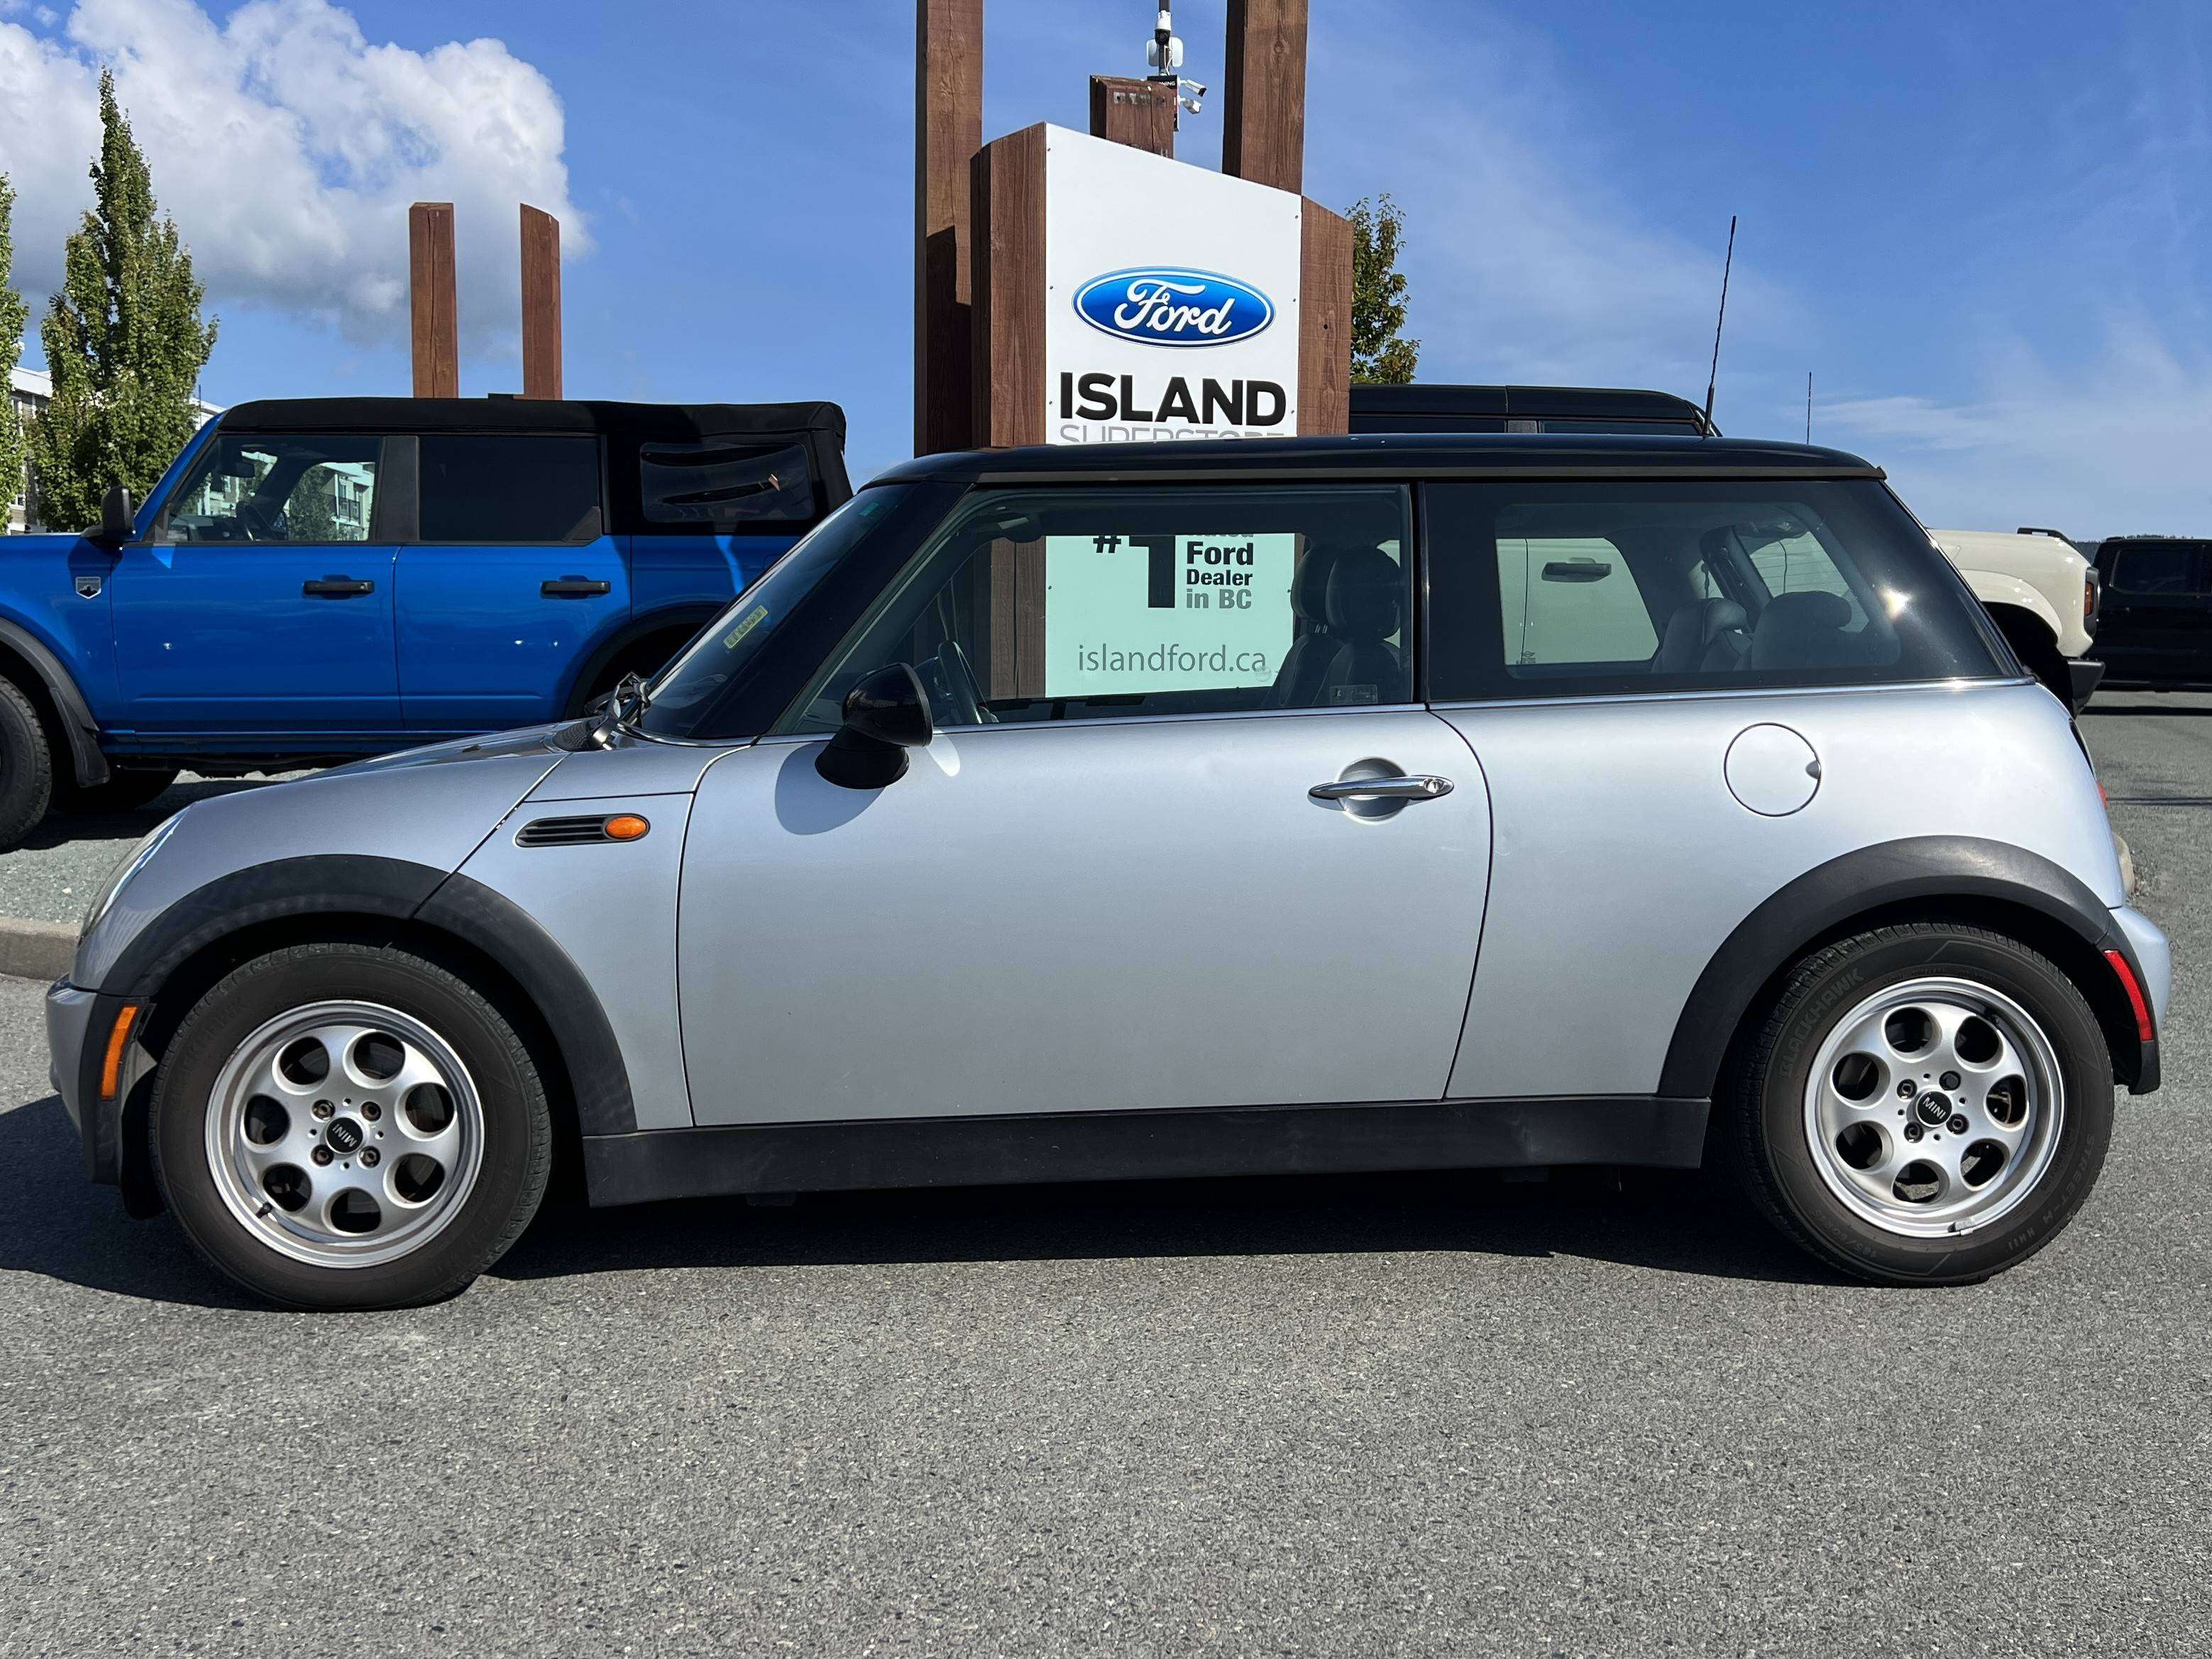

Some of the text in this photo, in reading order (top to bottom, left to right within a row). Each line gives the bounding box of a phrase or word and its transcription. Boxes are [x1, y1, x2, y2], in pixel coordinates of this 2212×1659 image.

[1114, 278, 1236, 335] Ford
[1060, 371, 1286, 426] ISLAND
[1187, 541, 1254, 566] Ford
[1187, 569, 1253, 586] Dealer
[1187, 588, 1252, 610] in BC
[1079, 643, 1266, 673] islandford.ca
[1778, 968, 1864, 1078] BLACKHAWK
[1922, 1096, 1947, 1120] MINI
[331, 1123, 357, 1147] MINI
